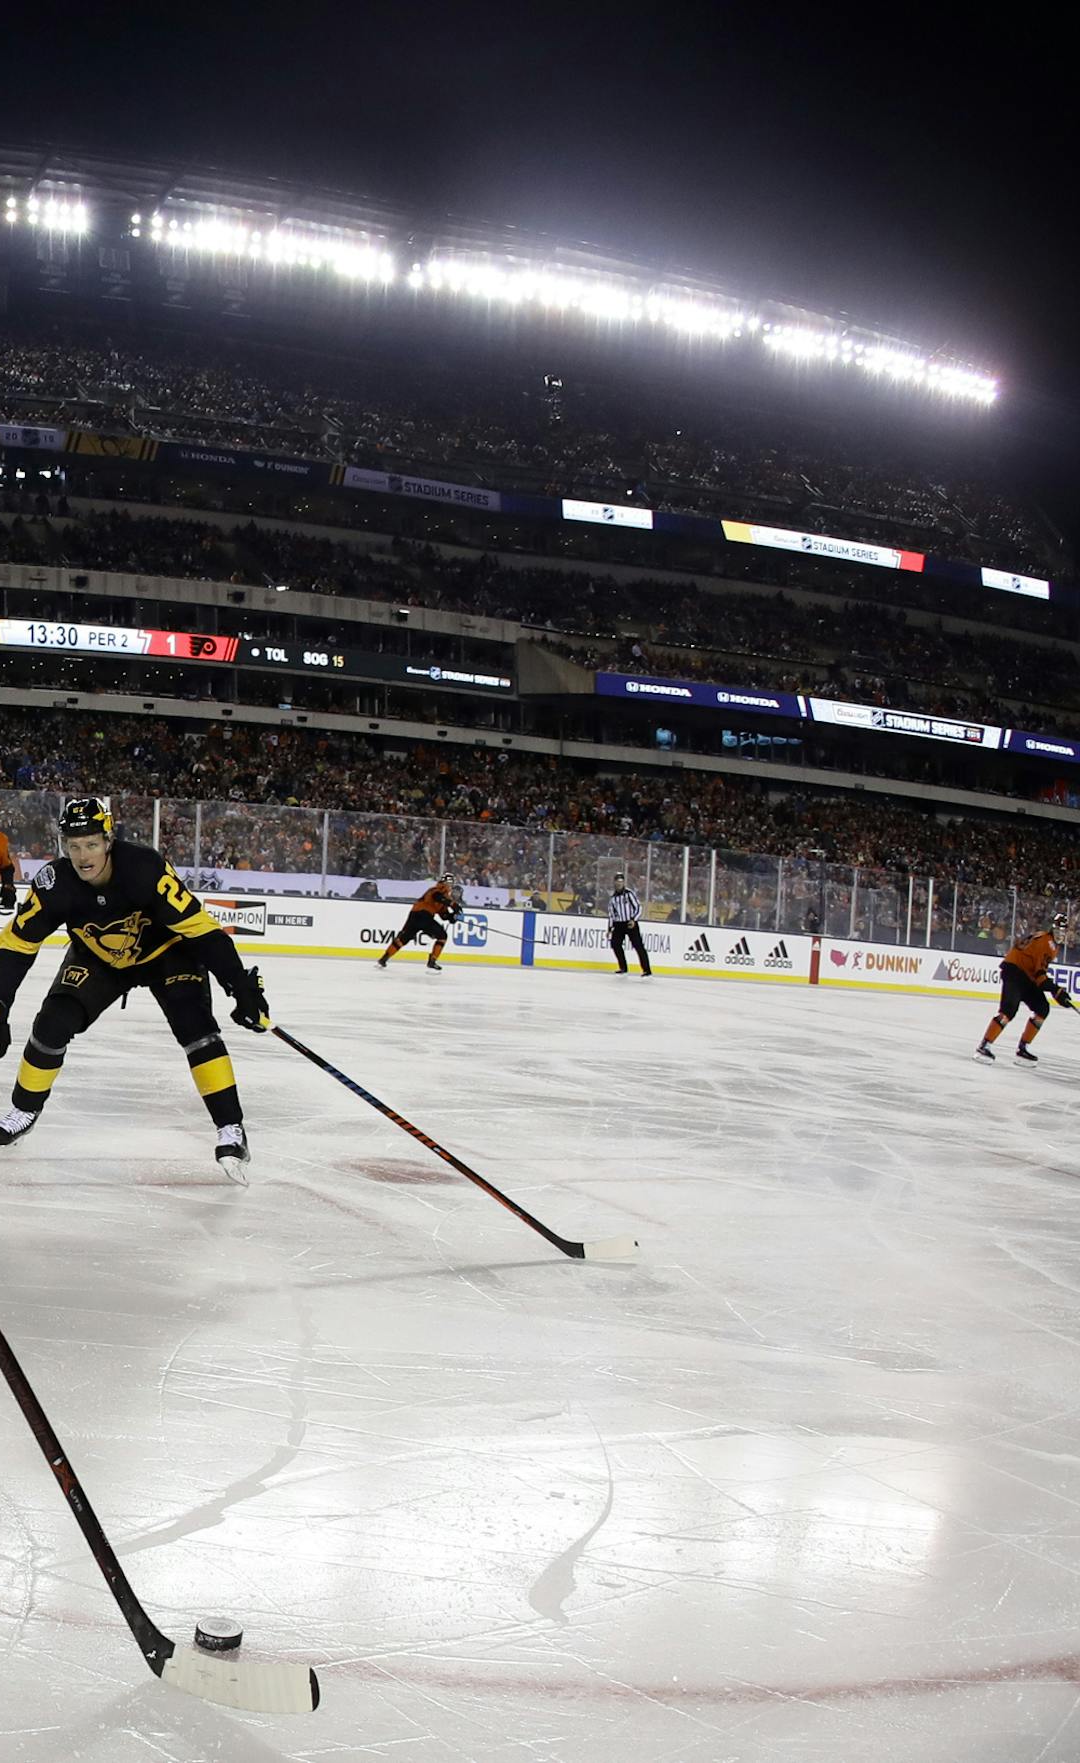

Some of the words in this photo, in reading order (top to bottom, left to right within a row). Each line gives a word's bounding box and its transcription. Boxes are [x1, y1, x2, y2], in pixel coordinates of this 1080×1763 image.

[190, 451, 236, 465] HONDA
[404, 481, 451, 499] STADIUM
[453, 490, 489, 506] SERIES
[813, 541, 850, 556] STADIUM
[851, 547, 879, 561] SERIES
[27, 624, 78, 646] 13:30
[88, 632, 116, 646] PER
[120, 634, 128, 648] 2
[166, 634, 176, 654] 1
[264, 647, 289, 662] TOL
[302, 651, 329, 666] SOG
[332, 655, 344, 668] 15
[640, 683, 692, 698] HONDA
[729, 694, 780, 709] HONDA
[885, 714, 930, 734] STADIUM
[932, 721, 966, 739] SERIES
[1035, 742, 1075, 756] HONDA
[274, 916, 284, 924] IN
[286, 917, 308, 926] HERE
[454, 914, 487, 944] PPG
[544, 926, 568, 947] NEW
[642, 932, 671, 954] VODKA
[683, 951, 716, 964] adidas
[724, 954, 755, 967] adidas
[764, 957, 793, 969] adidas
[866, 952, 922, 975] DUNKIN'
[66, 970, 83, 982] PIT
[948, 958, 982, 984] Coors
[984, 969, 1002, 985] LIG
[164, 973, 204, 986] CCM
